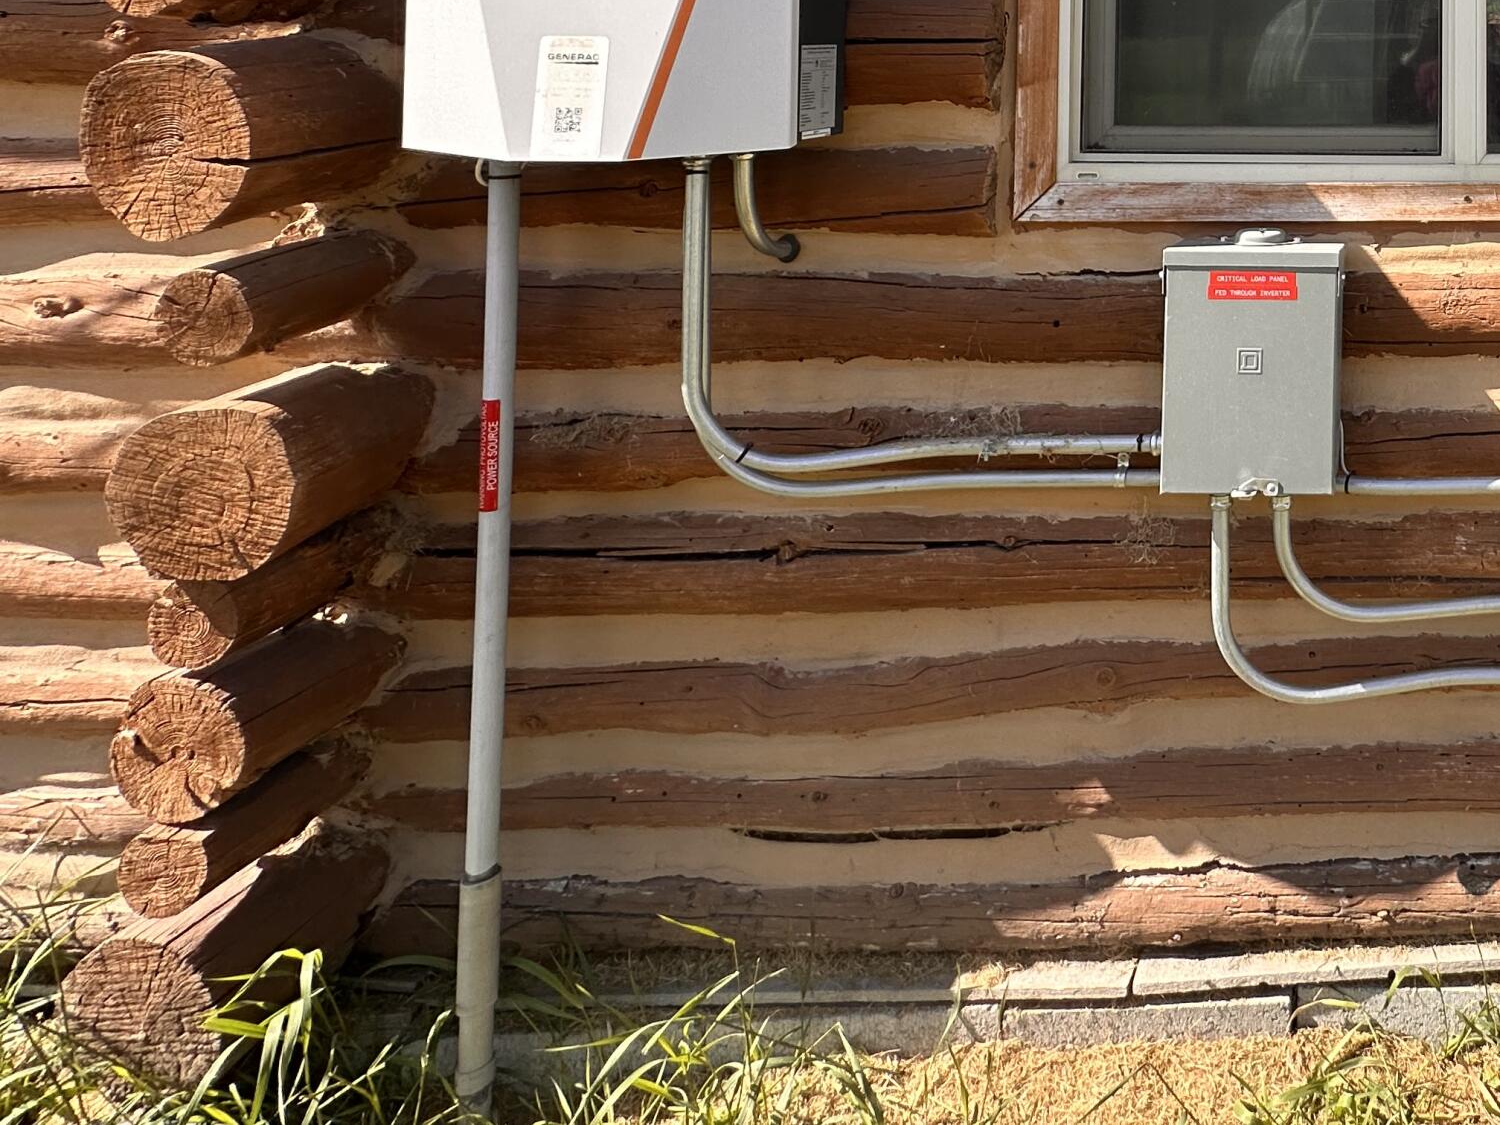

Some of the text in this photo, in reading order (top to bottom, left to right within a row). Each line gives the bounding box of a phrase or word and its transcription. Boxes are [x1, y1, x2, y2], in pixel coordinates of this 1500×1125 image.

[548, 53, 600, 61] GENERAC
[1216, 275, 1246, 283] CRITICAL
[487, 421, 498, 490] POWER SOURCE
